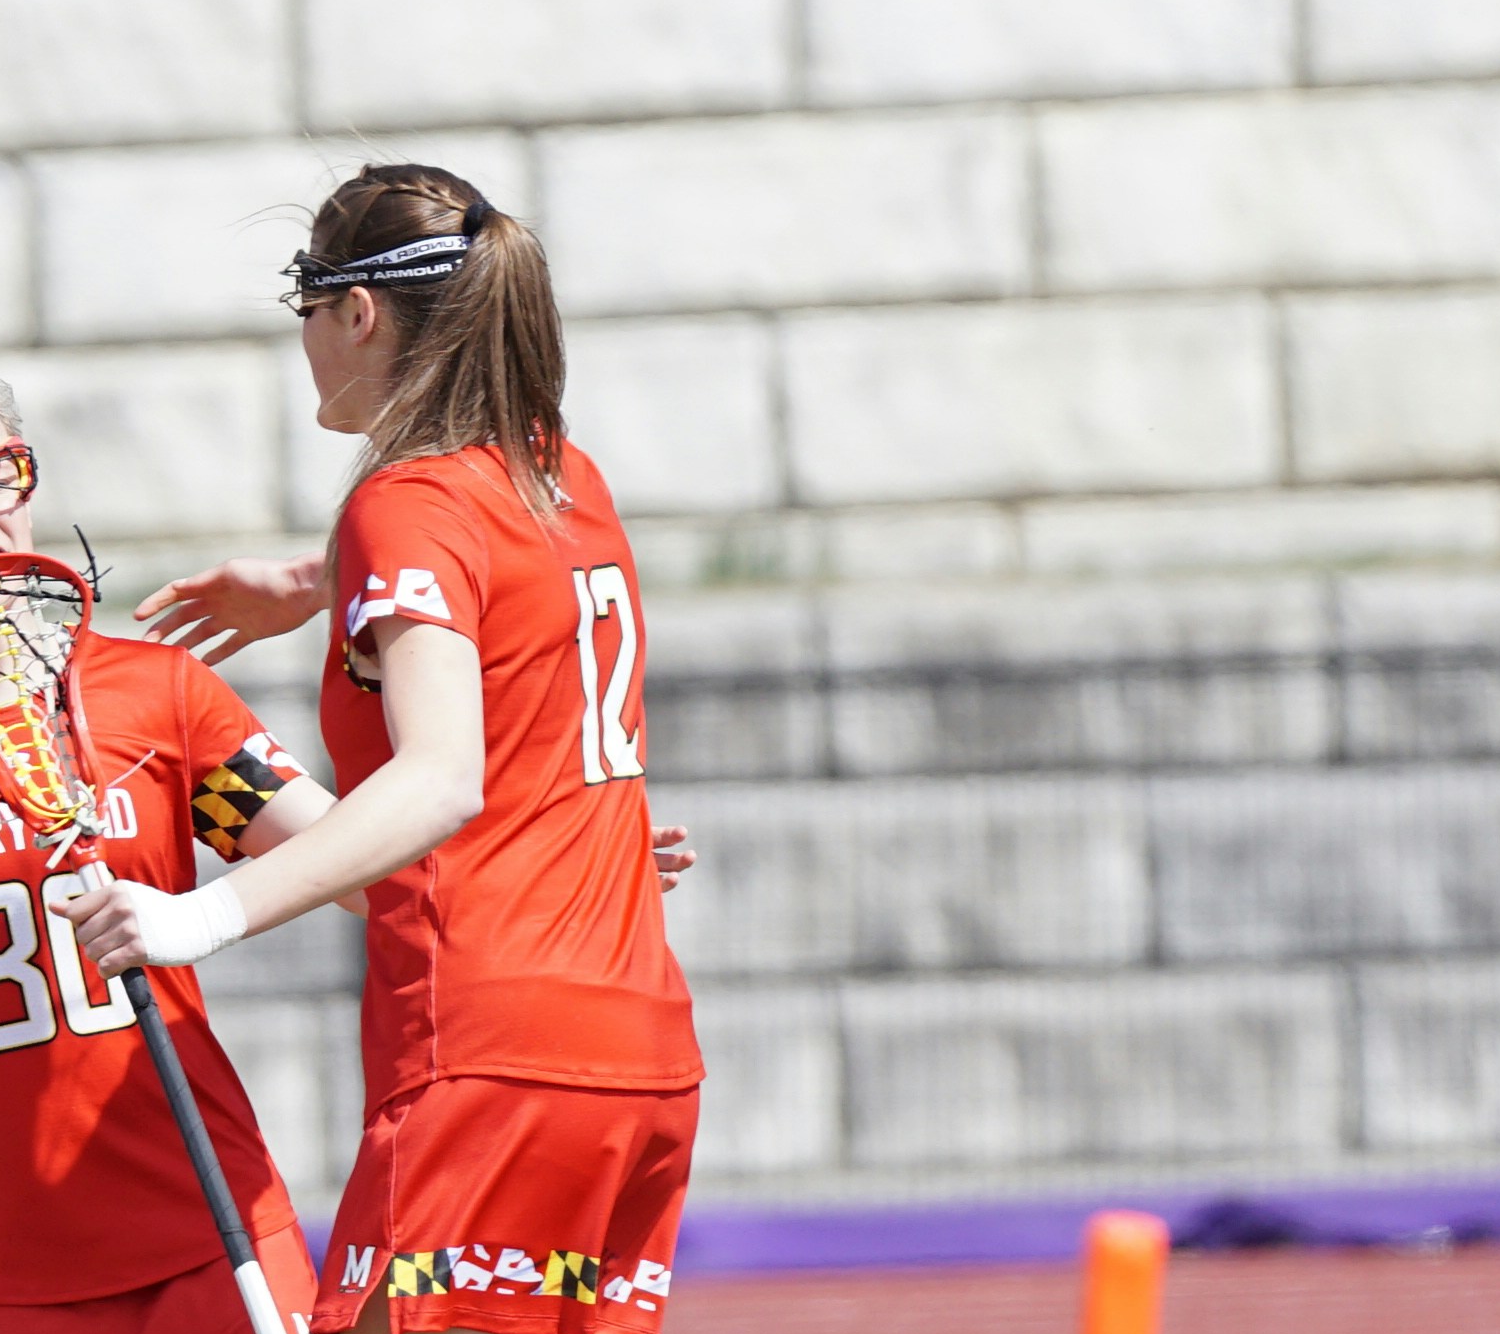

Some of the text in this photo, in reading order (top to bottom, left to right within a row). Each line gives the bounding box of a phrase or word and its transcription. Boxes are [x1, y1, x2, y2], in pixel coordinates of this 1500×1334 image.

[314, 263, 453, 286] UNDER ARMOUR
[572, 562, 646, 787] 12
[340, 1244, 377, 1288] M
